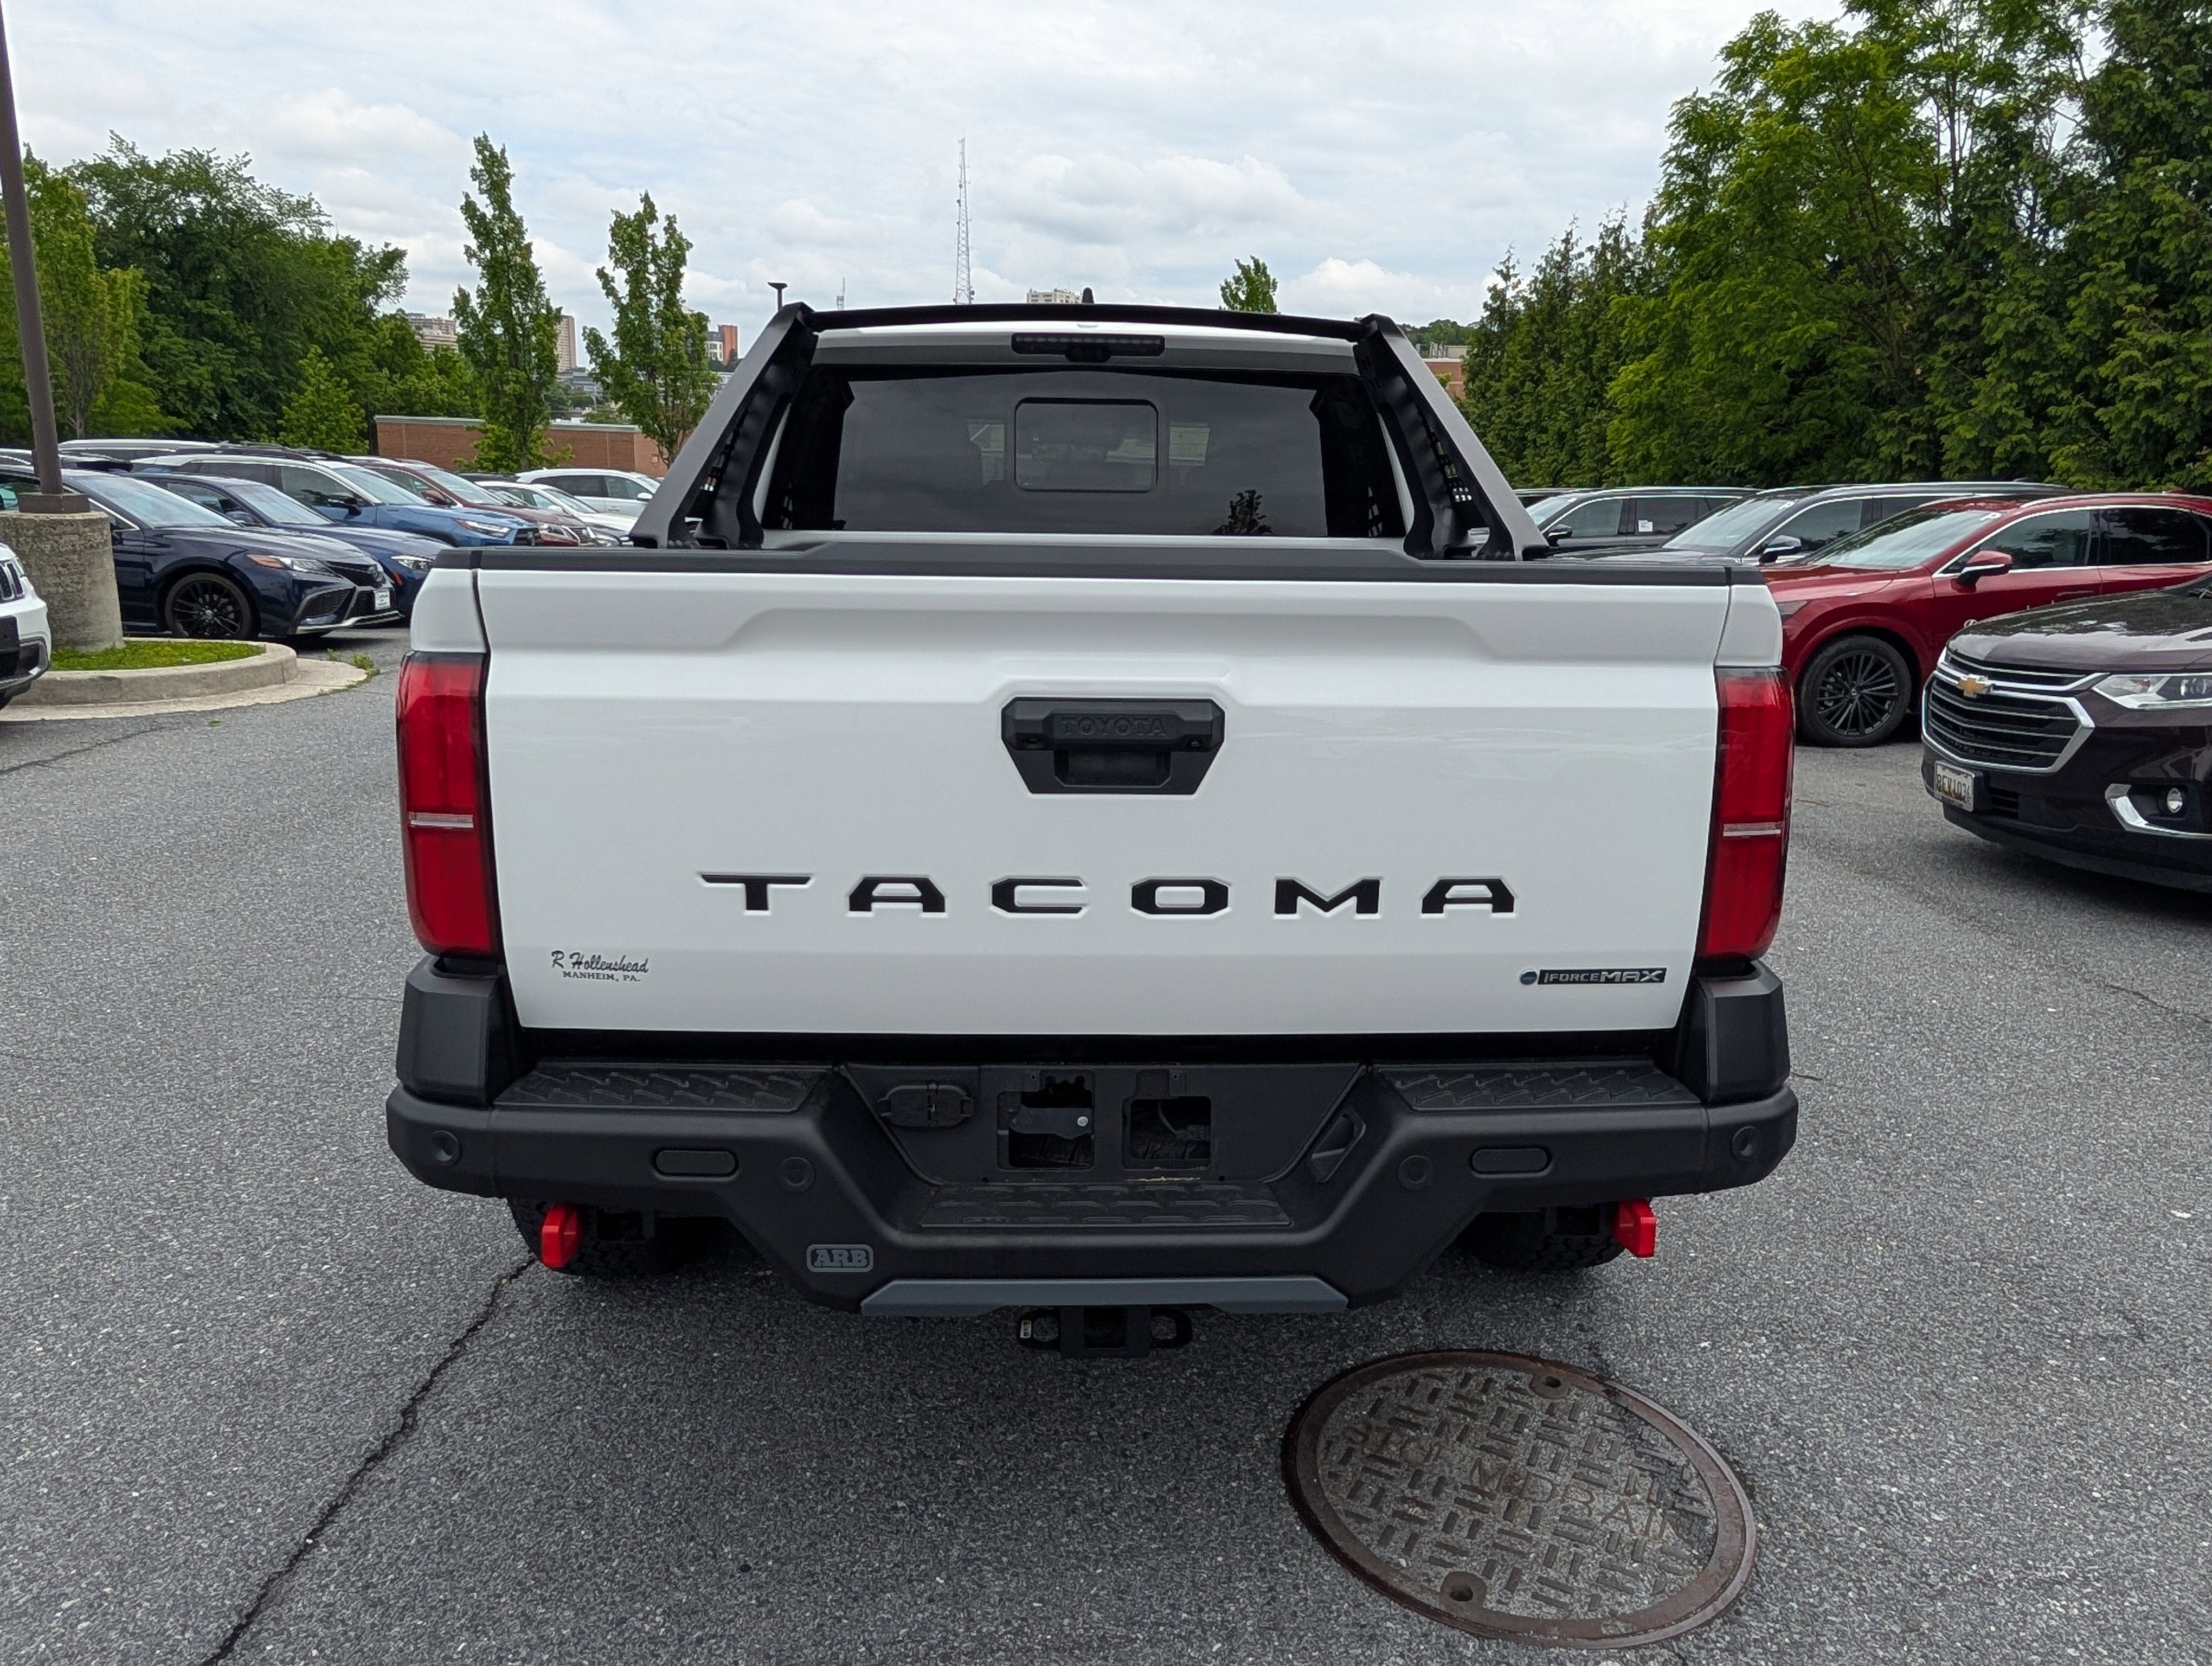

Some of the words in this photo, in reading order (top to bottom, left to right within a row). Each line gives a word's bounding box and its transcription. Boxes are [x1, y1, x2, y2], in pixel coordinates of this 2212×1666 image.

[1061, 716, 1166, 736] TOYOTA
[700, 873, 1516, 915] TACOMA
[551, 950, 565, 969] R
[569, 952, 650, 973] Hollenshead
[562, 971, 620, 982] MANHEIM,
[623, 974, 641, 982] PA.
[814, 1249, 867, 1267] ARB
